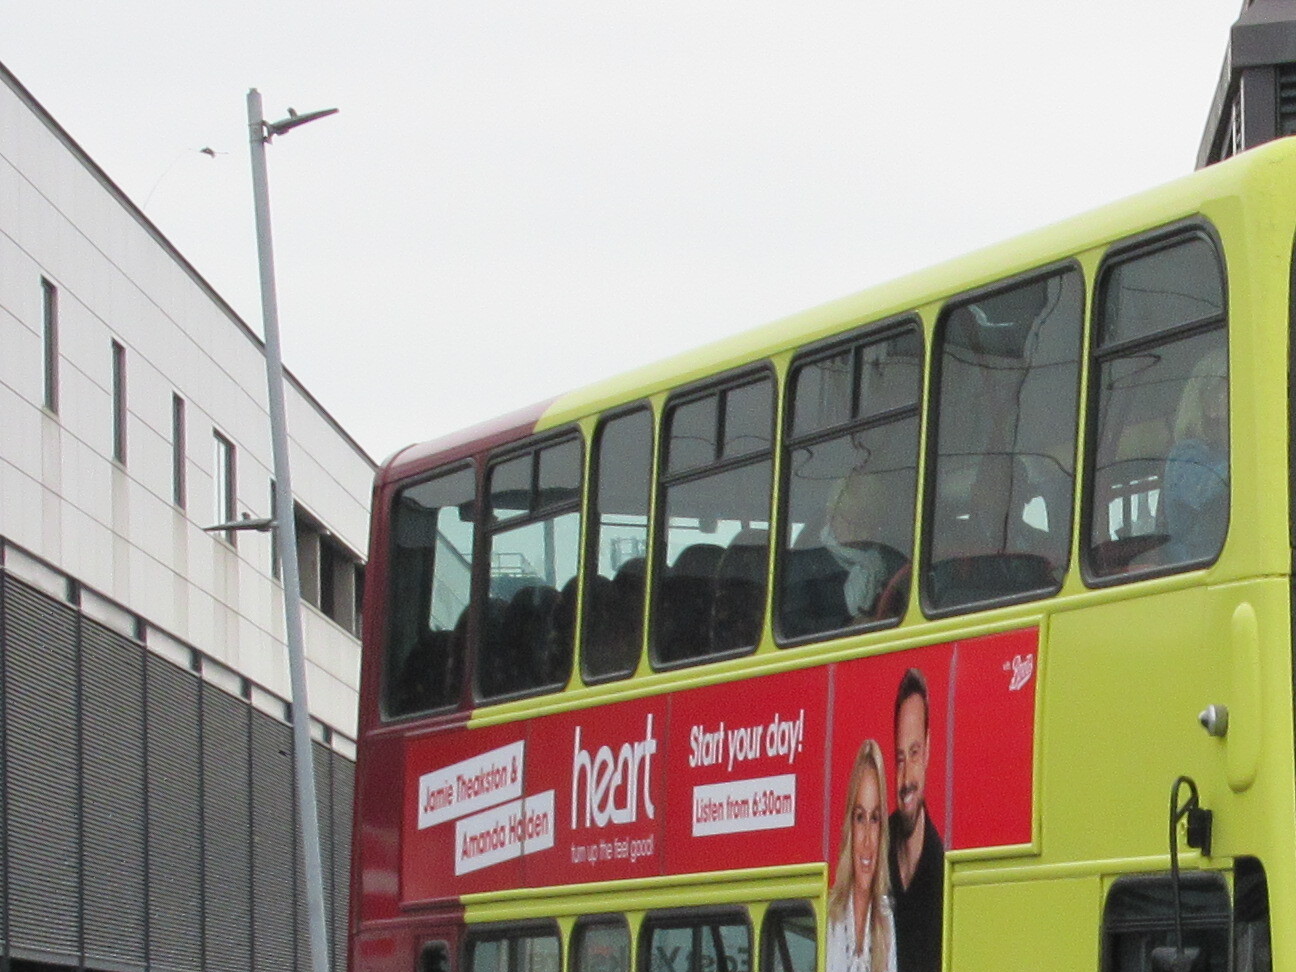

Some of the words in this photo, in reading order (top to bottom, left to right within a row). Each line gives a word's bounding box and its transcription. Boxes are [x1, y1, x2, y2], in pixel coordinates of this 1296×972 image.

[689, 721, 724, 768] Start
[728, 724, 764, 772] your
[765, 708, 805, 765] day!
[424, 779, 454, 814] Jamie
[456, 763, 508, 802] Theakston
[510, 755, 519, 784] &
[571, 713, 657, 830] heart
[461, 820, 507, 861] Amanda
[508, 808, 549, 845] Holden
[696, 797, 724, 823] Listen
[727, 794, 750, 820] from
[752, 789, 792, 817] 6:30am
